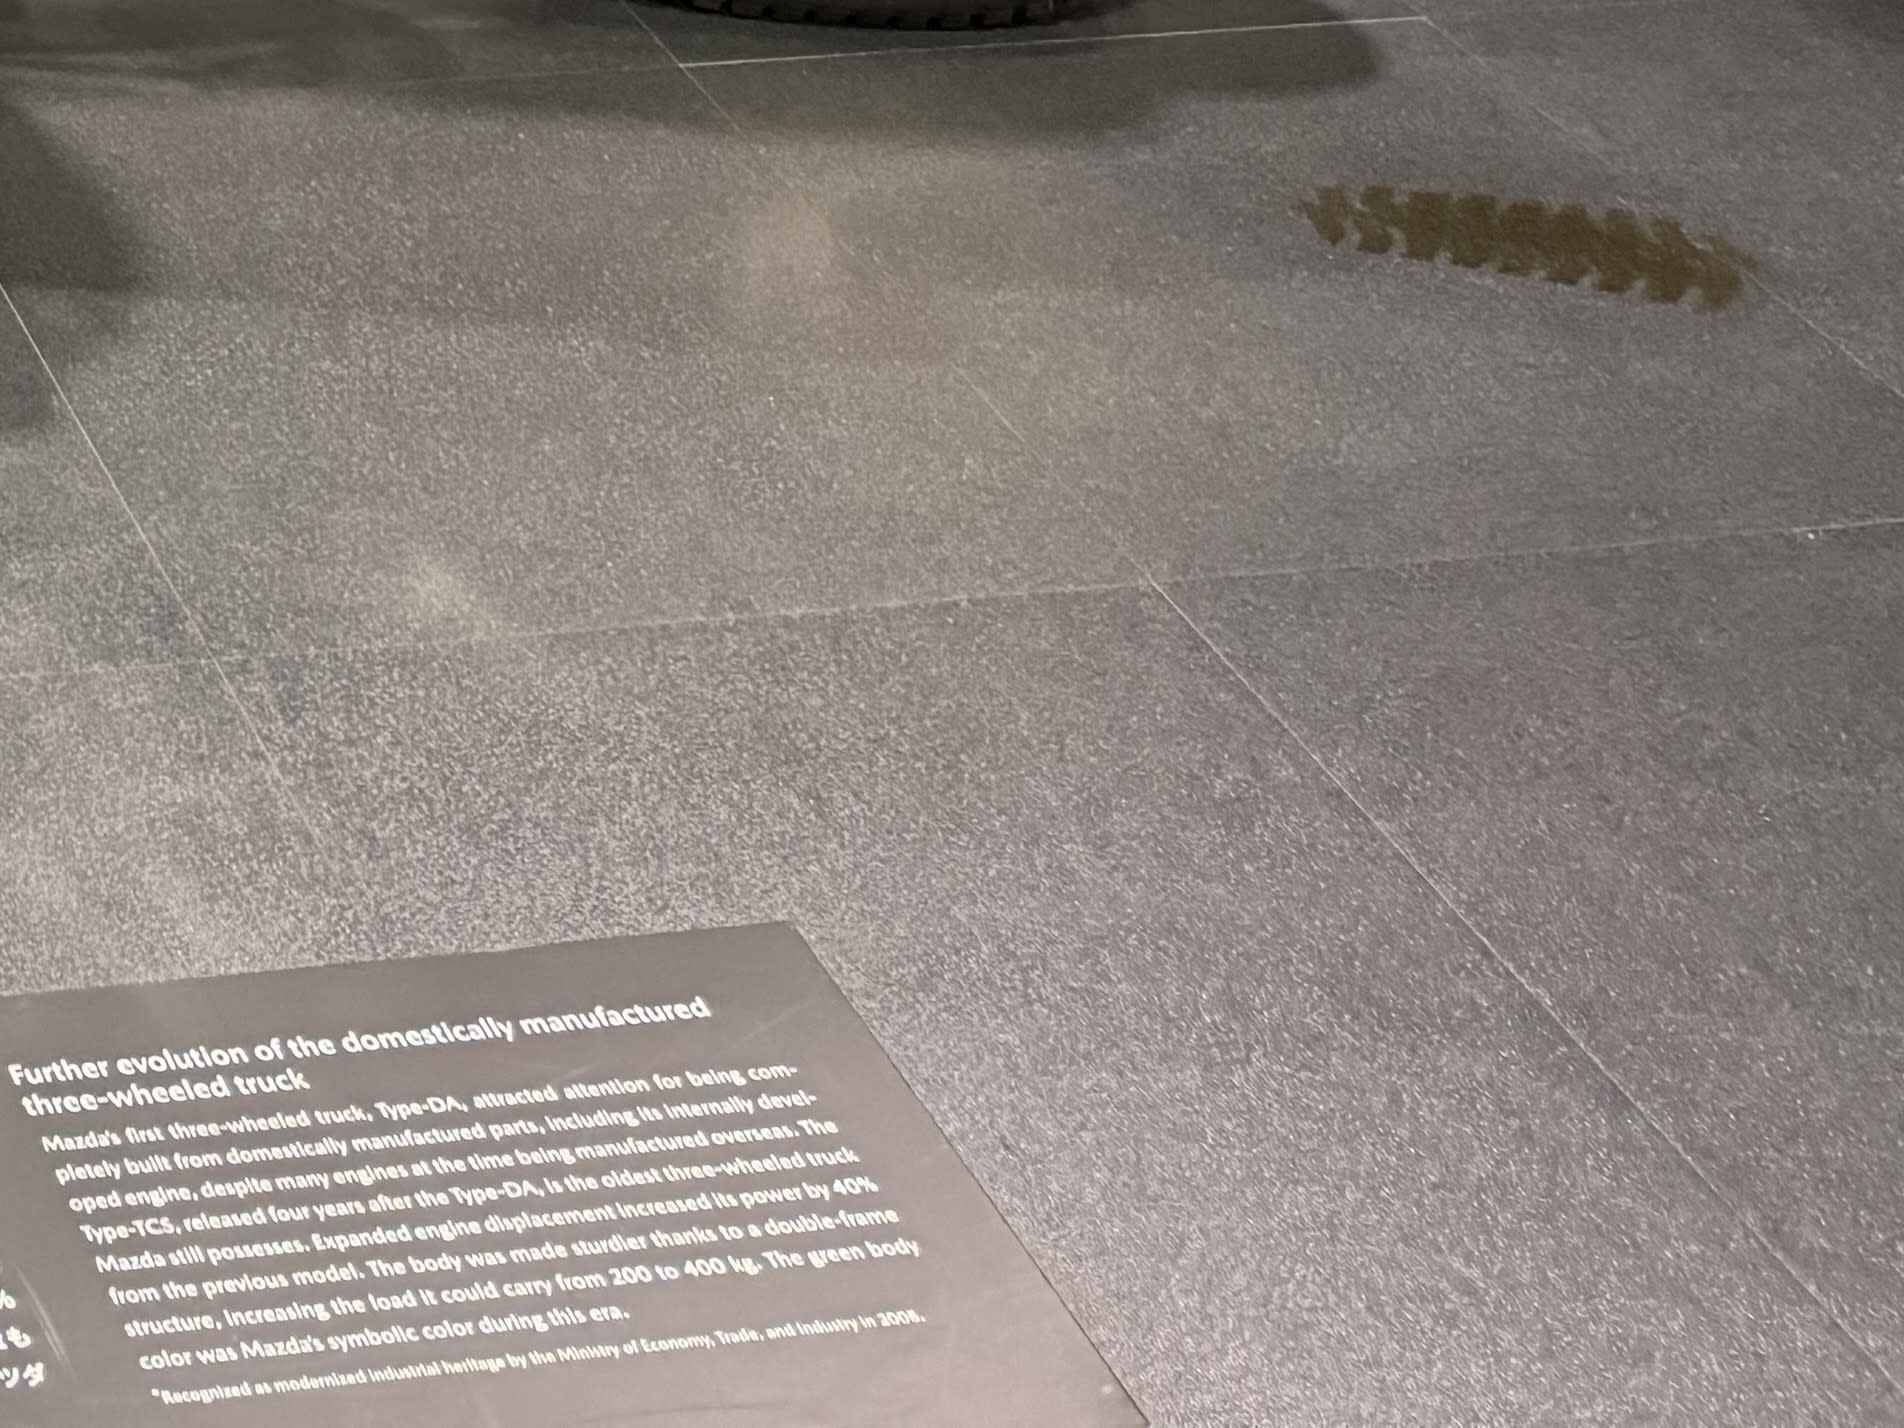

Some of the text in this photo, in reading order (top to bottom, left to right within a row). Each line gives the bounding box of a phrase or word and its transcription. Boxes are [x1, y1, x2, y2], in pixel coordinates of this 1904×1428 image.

[7, 996, 712, 1086] Further evolution of the domestically manufactured
[21, 1067, 311, 1116] three-wheeled truck
[55, 1089, 817, 1186] pletely built from domestically manufactured parts, including its internally devel-
[124, 1126, 166, 1144] first
[167, 1109, 312, 1140] three-wheeled
[314, 1104, 374, 1125] truck,
[374, 1095, 469, 1121] Type-DA,
[472, 1084, 559, 1109] attracted
[563, 1078, 651, 1100] attention
[652, 1073, 683, 1091] for
[684, 1068, 748, 1087] being
[747, 1064, 798, 1081] com-
[68, 1118, 839, 1215] oped engine, despite many engines at the time being manufactured overseas. The
[79, 1146, 860, 1245] Type-TCS, released four years after the Type-DA, is the oldest three-wheeled truck
[95, 1176, 879, 1273] Mazda still possesses. Expanded engine displacement increased its power by 40%
[108, 1209, 900, 1307] from the previous model. The body was made sturdier thanks to a double-frame
[124, 1237, 920, 1338] structure, increasing the load it could carry from 200 to 400 kg. The green body
[139, 1349, 192, 1370] color
[195, 1346, 239, 1365] was
[327, 1325, 420, 1353] symbolic
[421, 1319, 475, 1340] color
[478, 1313, 549, 1334] during
[546, 1306, 587, 1327] this
[588, 1305, 631, 1322] era.
[254, 1381, 273, 1395] as
[273, 1369, 368, 1393] modernized
[367, 1361, 442, 1383] industrial
[440, 1357, 506, 1375] heritage
[505, 1352, 527, 1369] by
[527, 1350, 557, 1365] the
[556, 1344, 620, 1362] Ministry
[622, 1339, 639, 1355] of
[639, 1335, 716, 1353] Economy,
[713, 1327, 765, 1345] Trade,
[857, 1315, 877, 1329] in
